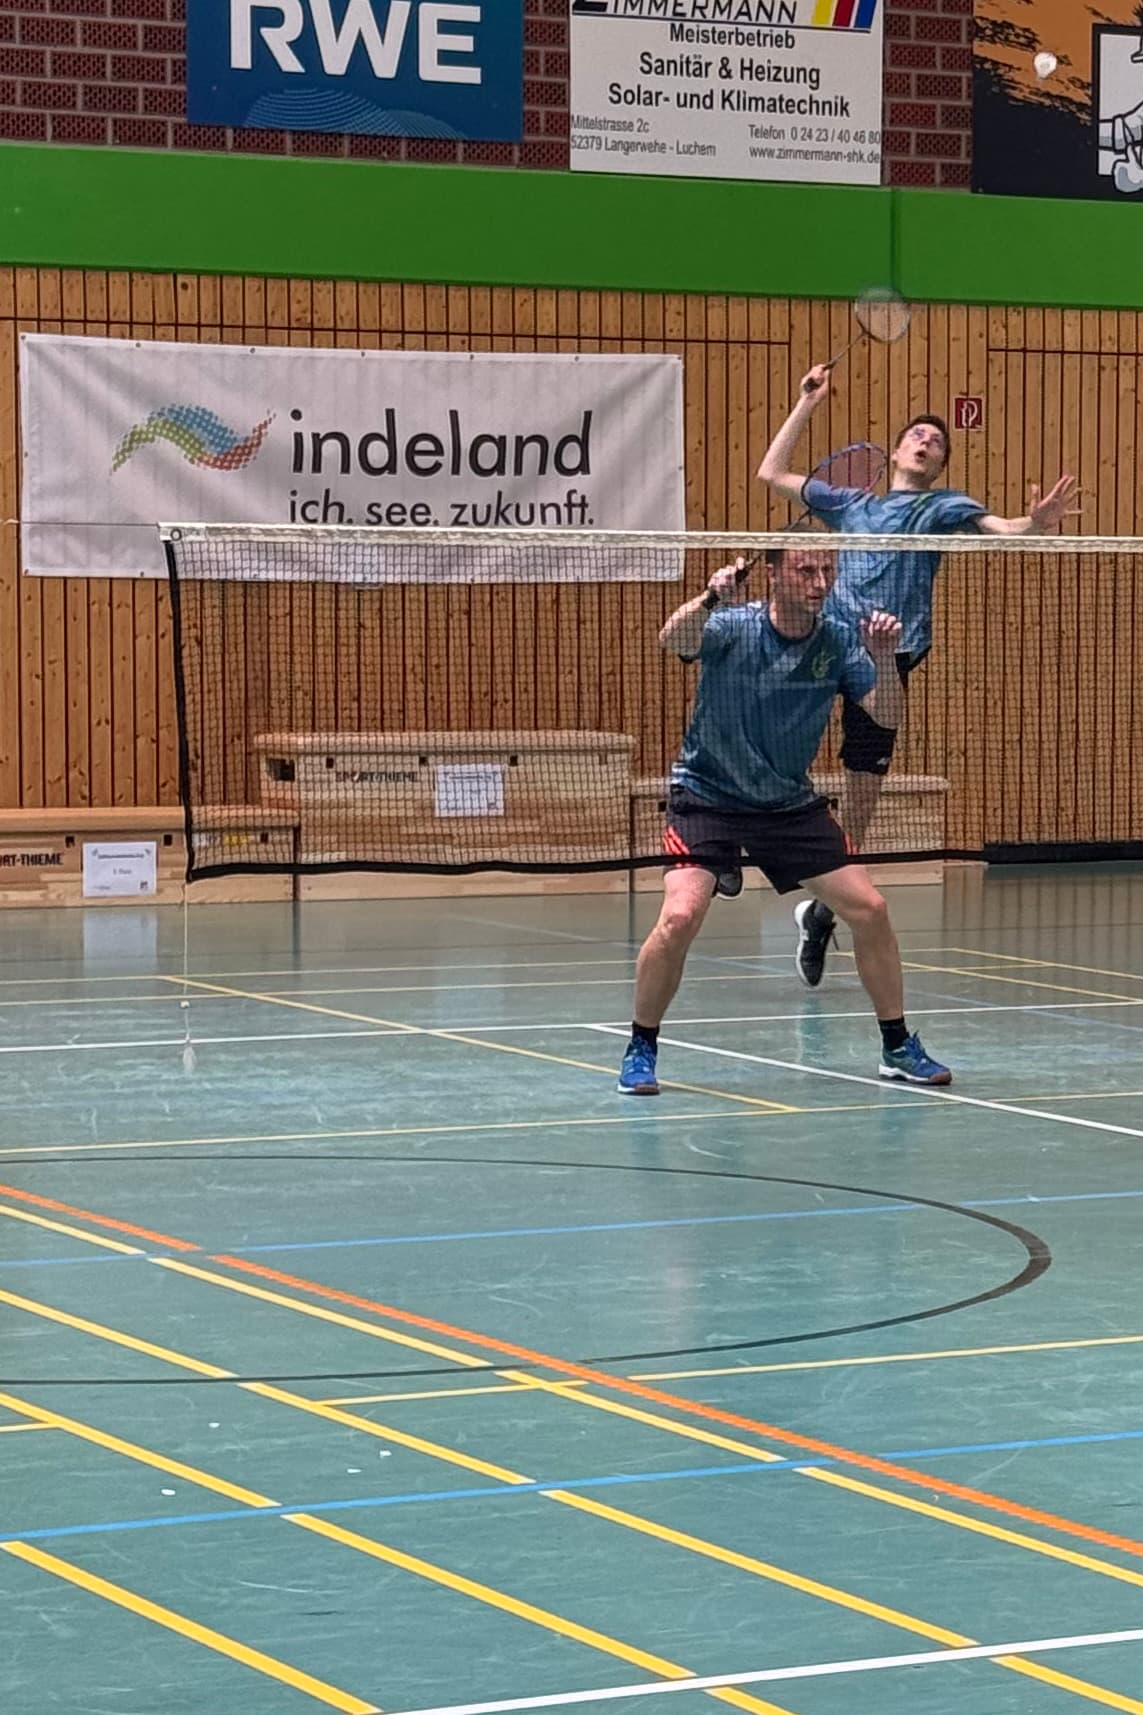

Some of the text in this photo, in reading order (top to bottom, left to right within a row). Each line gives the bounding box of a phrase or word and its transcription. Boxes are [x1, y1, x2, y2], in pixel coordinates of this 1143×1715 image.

[230, 0, 481, 85] RWE
[669, 23, 796, 49] Meisterbetrieb
[639, 52, 821, 90] Sanitär & Heizung
[608, 83, 850, 117] Solar- und Klimatechnik
[571, 115, 650, 133] Mittelstrasse 2c
[748, 124, 785, 140] Telefon
[790, 126, 798, 141] 0
[800, 127, 813, 141] 24
[815, 128, 829, 142] 23
[837, 128, 851, 143] 40
[853, 129, 866, 144] 46
[868, 130, 881, 145] 80
[571, 134, 602, 150] 52379
[604, 137, 667, 156] Langerwehe
[676, 139, 716, 156] Luchem
[749, 146, 880, 163] www.zimmermann-shk.de
[290, 407, 593, 478] indeland
[289, 488, 594, 527] ich. see. zukunft.
